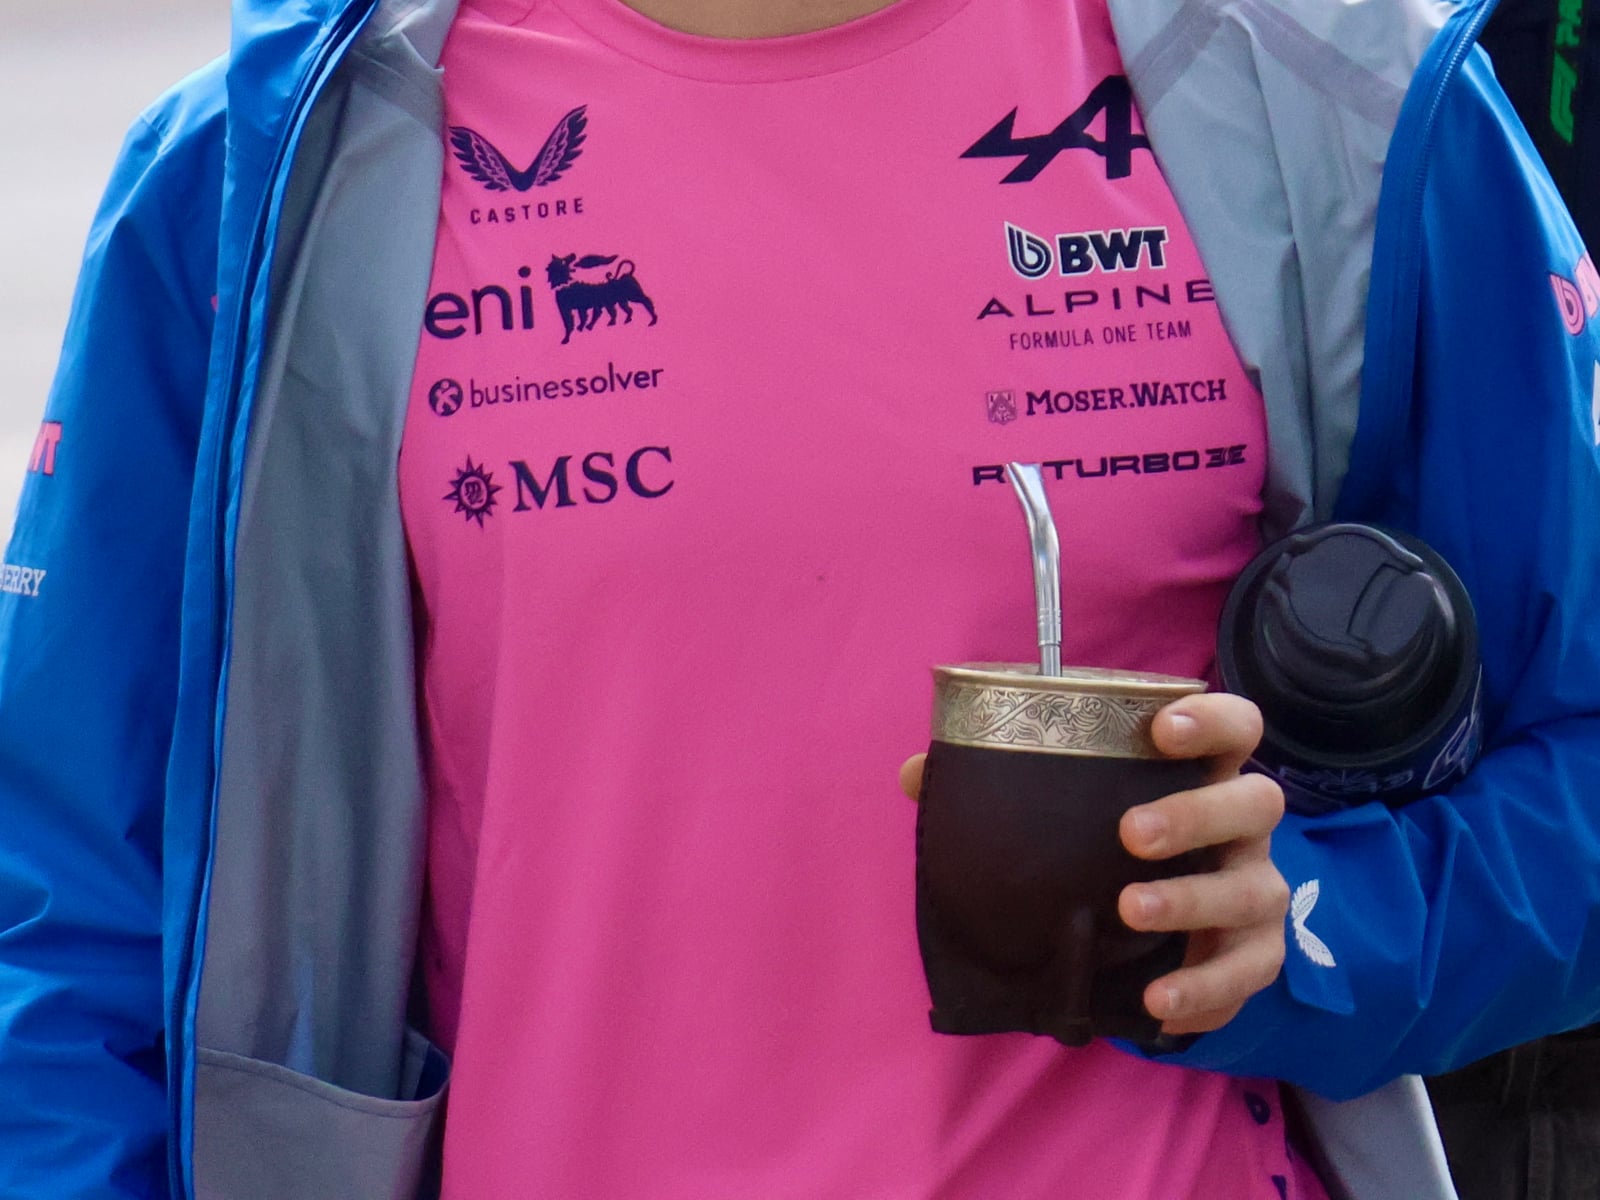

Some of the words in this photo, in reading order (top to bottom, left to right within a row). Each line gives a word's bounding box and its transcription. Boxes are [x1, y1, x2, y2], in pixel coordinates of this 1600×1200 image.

[470, 197, 583, 224] CASTORE
[1056, 226, 1169, 276] BWT
[424, 265, 535, 339] eni
[976, 279, 1216, 320] ALPINE
[1009, 329, 1094, 350] FORMULA
[1103, 324, 1137, 344] ONE
[1147, 320, 1192, 340] TEAM
[470, 362, 664, 408] businessolver
[508, 446, 675, 513] MSC
[972, 450, 1200, 486] RTURBO
